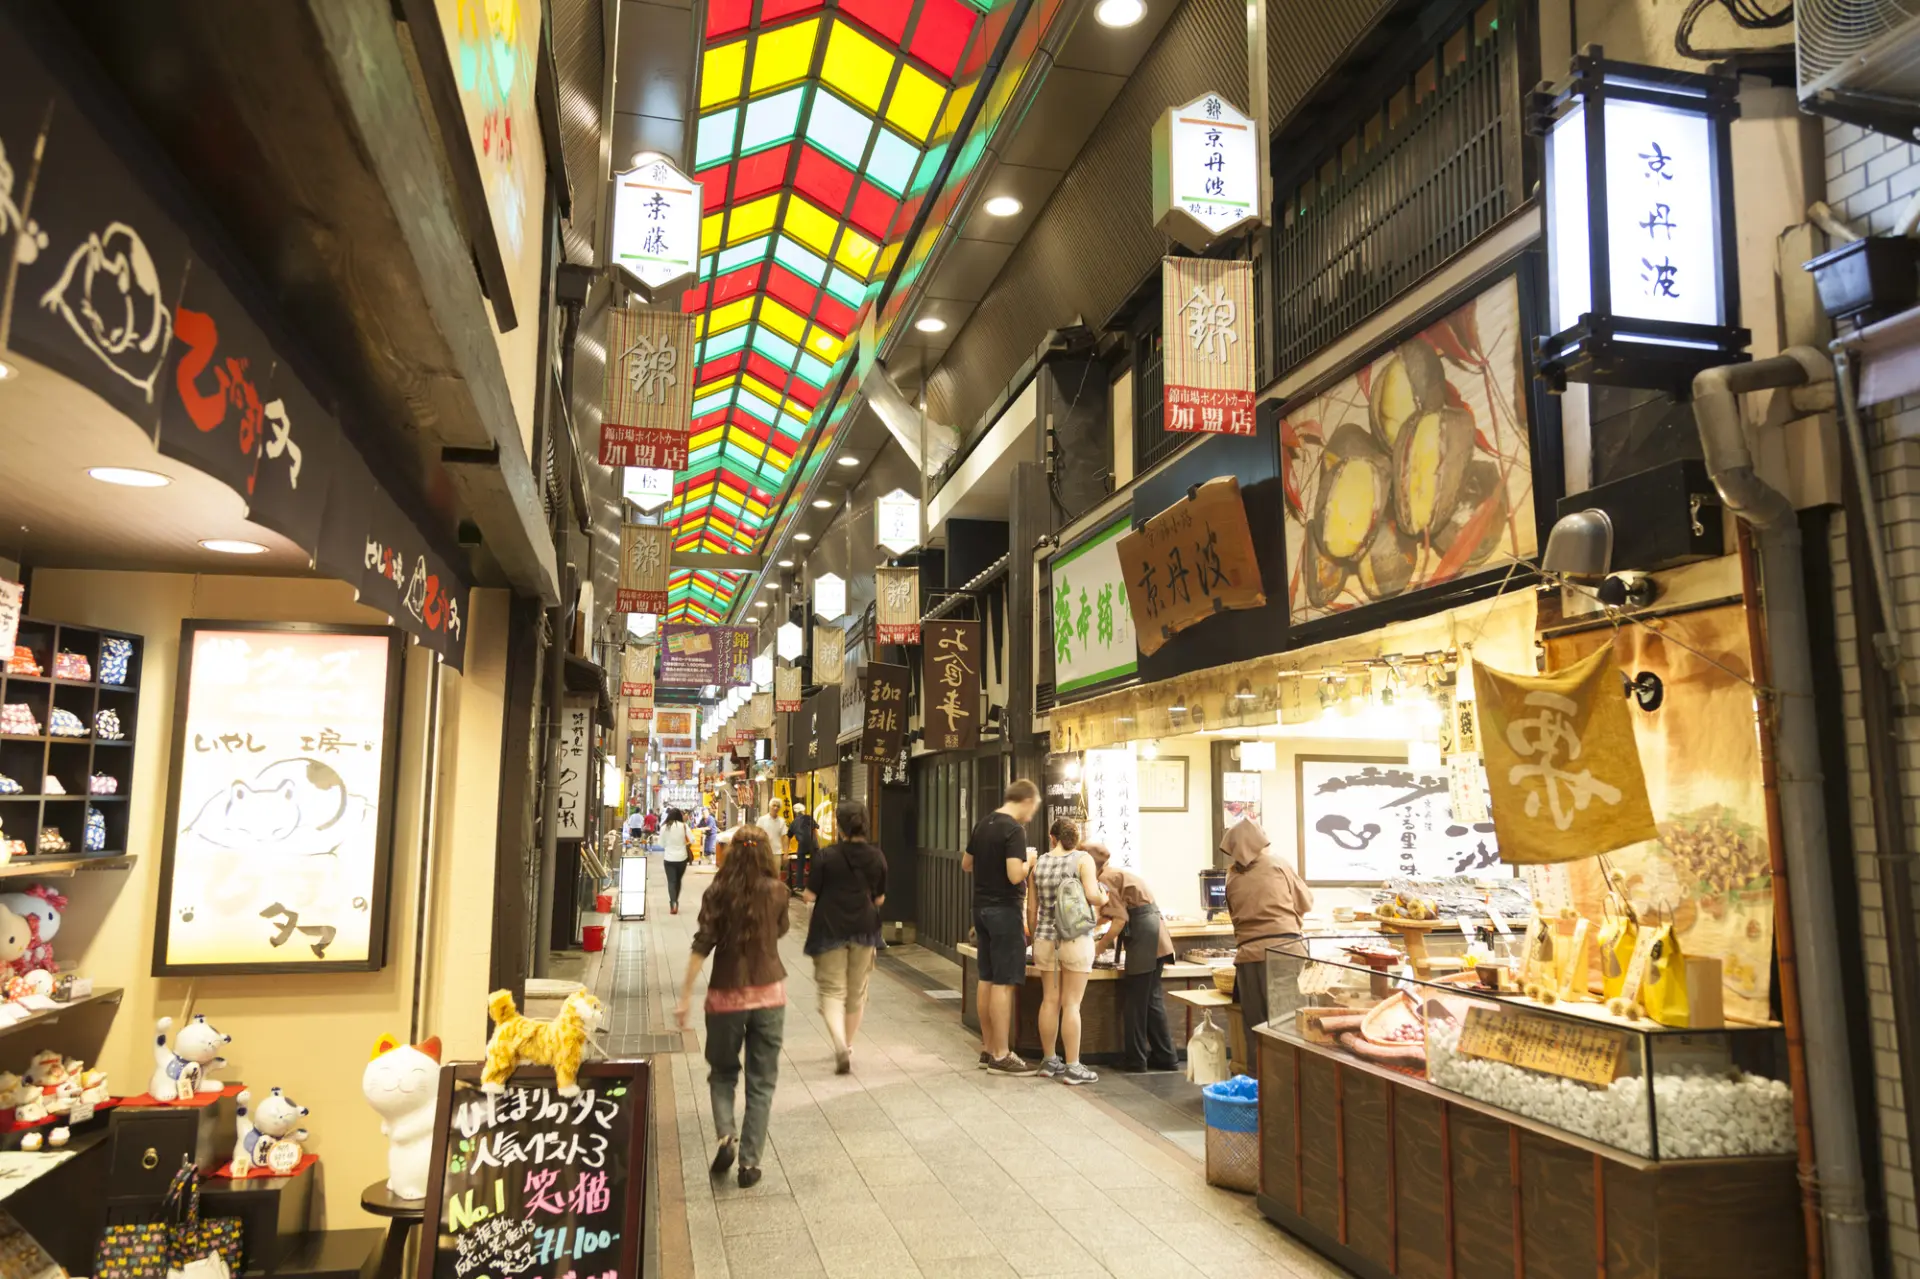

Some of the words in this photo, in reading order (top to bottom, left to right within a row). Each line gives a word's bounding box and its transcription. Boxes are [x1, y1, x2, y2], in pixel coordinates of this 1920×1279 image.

[1204, 128, 1226, 197] 京丹波
[1638, 141, 1680, 298] 京丹波
[1177, 286, 1239, 364] 錦
[618, 334, 678, 405] 錦
[1168, 387, 1253, 407] 錦市場ポイントカード
[1168, 405, 1253, 435] 加盟店
[603, 441, 687, 470] 加盟店
[604, 426, 687, 445] 錦市場ポイントカード
[627, 535, 661, 578] 錦
[1138, 520, 1232, 618] 京丹波
[619, 600, 667, 614] 加盟店
[882, 575, 912, 612] 錦
[933, 626, 976, 732] お食事
[868, 679, 900, 732] 珈琲
[195, 732, 266, 754] いやし
[300, 728, 357, 754] 工房
[1506, 690, 1622, 831] 栗
[1400, 806, 1421, 876] ふる里の味
[259, 901, 337, 960] タマ
[455, 1087, 620, 1138] ひだまりのタマ
[470, 1131, 608, 1175] 人気ベスト3
[523, 1168, 611, 1219] 笑い猫
